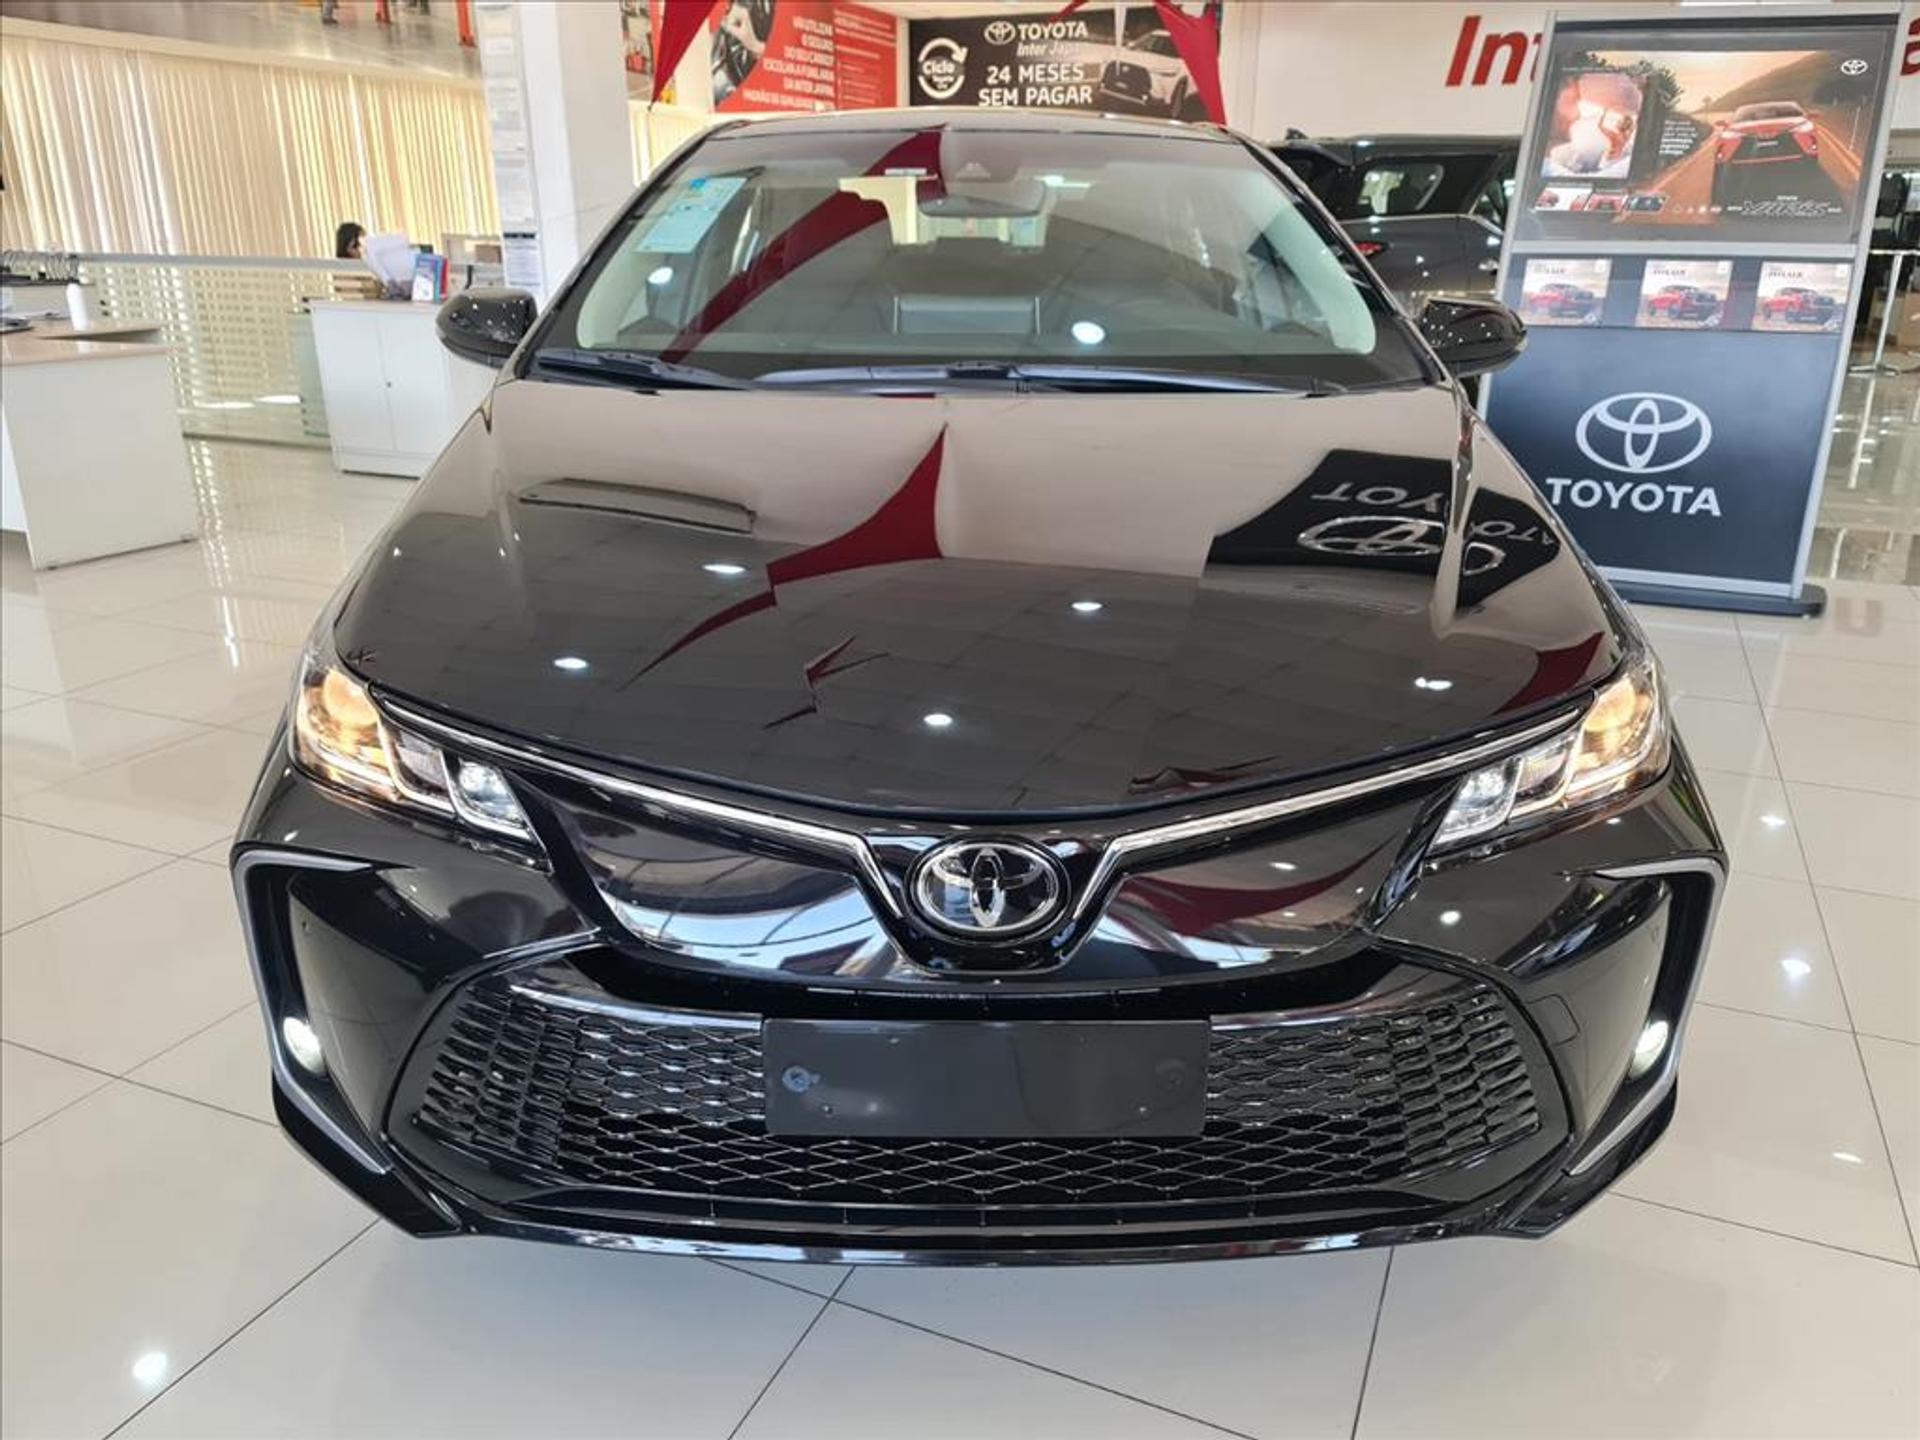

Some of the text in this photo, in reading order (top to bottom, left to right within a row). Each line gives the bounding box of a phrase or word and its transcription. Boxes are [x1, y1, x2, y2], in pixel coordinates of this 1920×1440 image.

[1017, 21, 1088, 41] TOYOTA
[1017, 42, 1048, 57] Inter
[922, 60, 955, 75] Ciclo
[987, 63, 1084, 85] 24 MESES
[978, 85, 1092, 107] SEM PAGAR
[1545, 477, 1722, 517] TOYOTA
